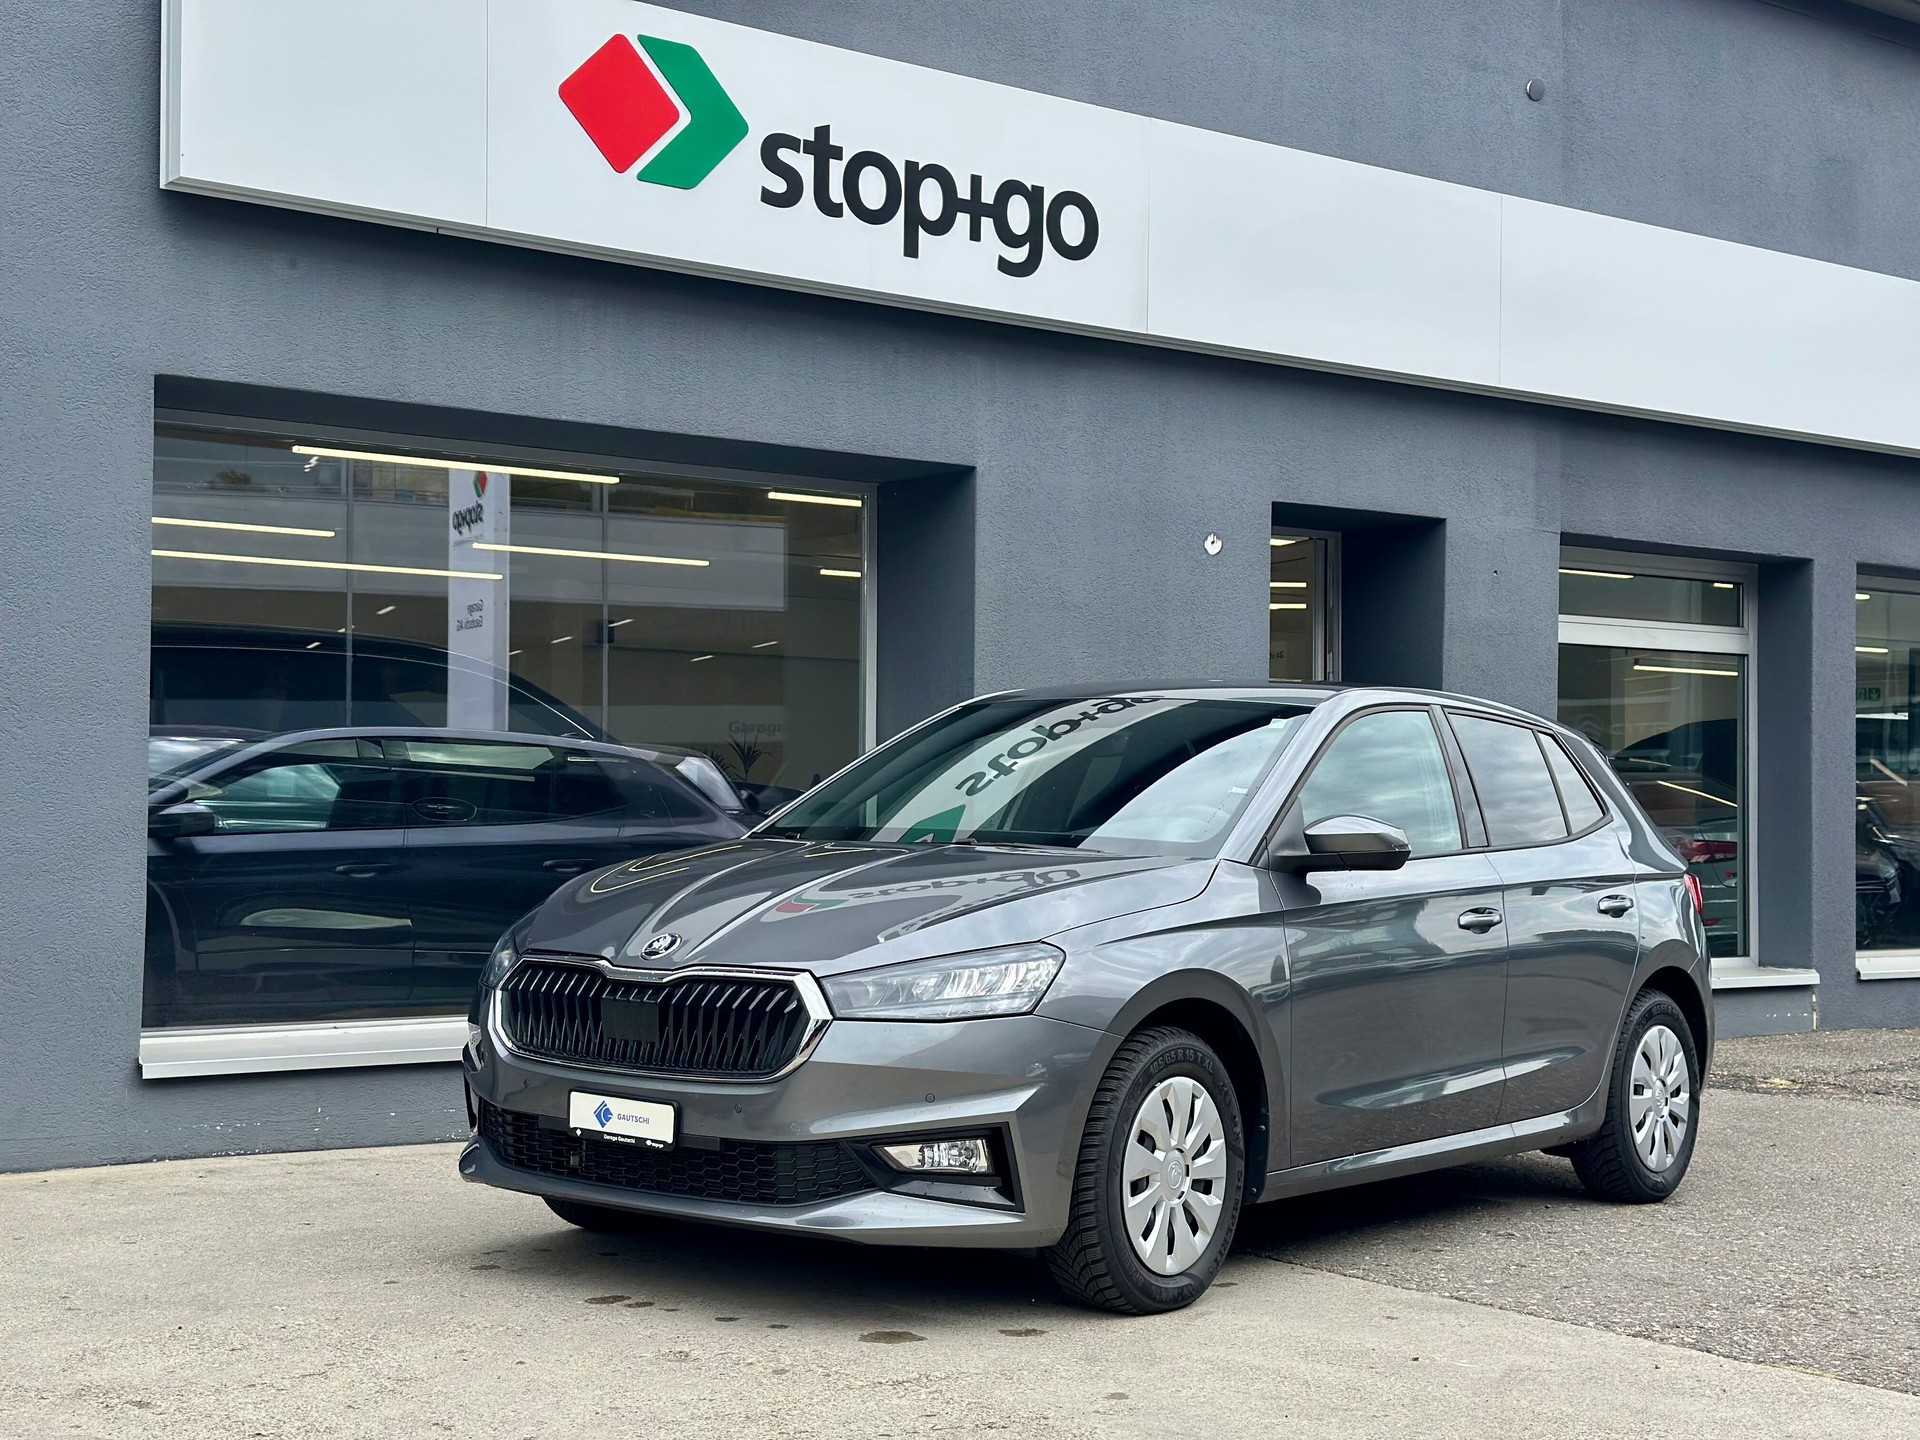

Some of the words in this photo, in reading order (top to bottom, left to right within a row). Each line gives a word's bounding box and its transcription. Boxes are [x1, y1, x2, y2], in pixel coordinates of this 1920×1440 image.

[760, 124, 1099, 278] stop+go
[1177, 1049, 1184, 1061] R
[1185, 1049, 1194, 1062] 15
[617, 1113, 650, 1125] GAUTSCHI
